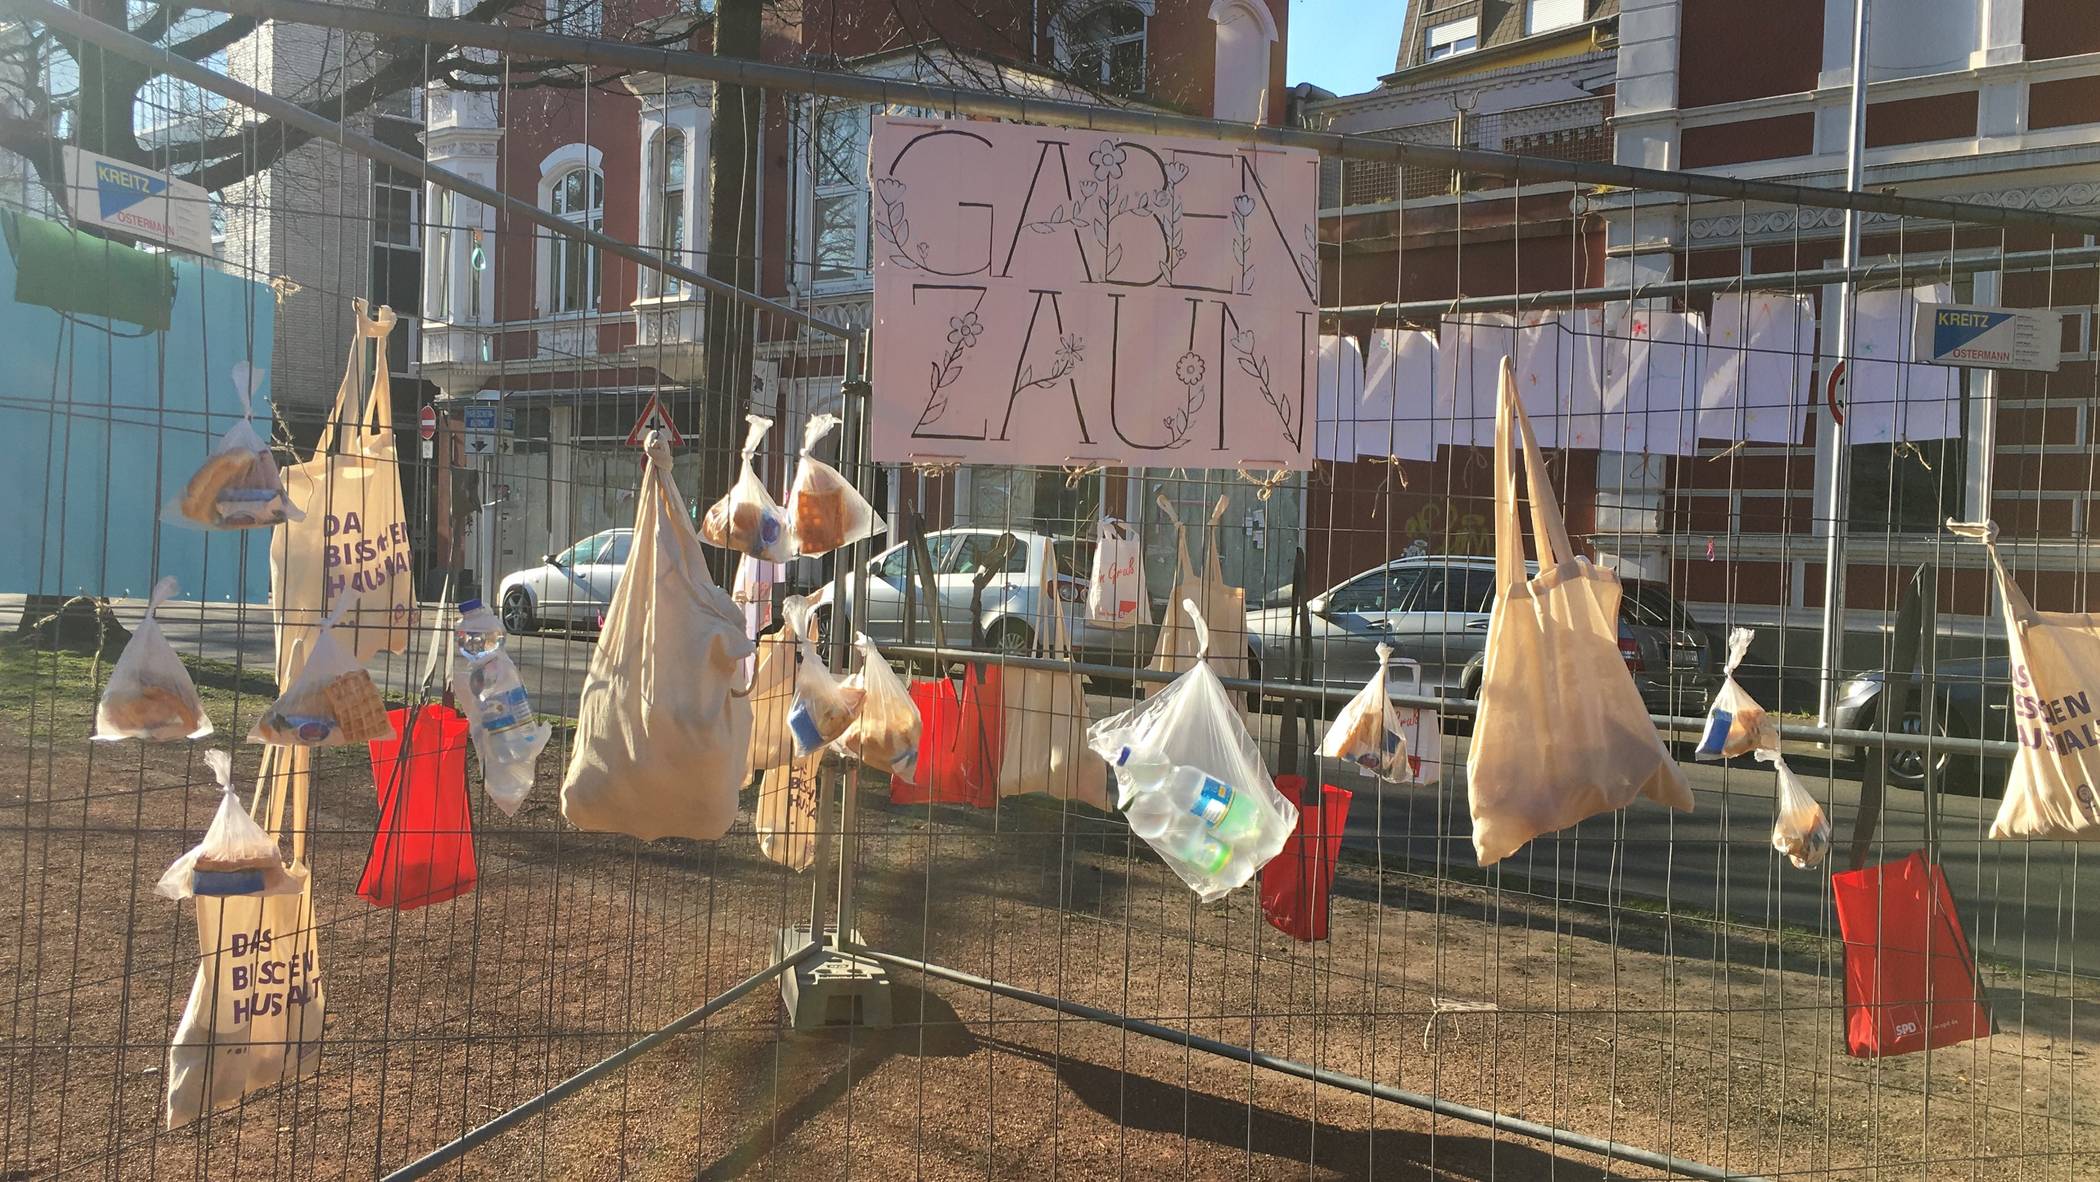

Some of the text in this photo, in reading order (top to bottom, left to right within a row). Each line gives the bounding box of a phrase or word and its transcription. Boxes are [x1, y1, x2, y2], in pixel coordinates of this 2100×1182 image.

[98, 165, 151, 193] KREITZ
[117, 212, 175, 236] OSTERMANN
[877, 130, 1318, 305] GABEN
[1938, 312, 1989, 328] KREITZ
[1952, 348, 2010, 361] OSTERMANN
[911, 283, 1314, 454] ZAUN
[232, 928, 272, 958] DAS
[1895, 1021, 1917, 1036] SPD
